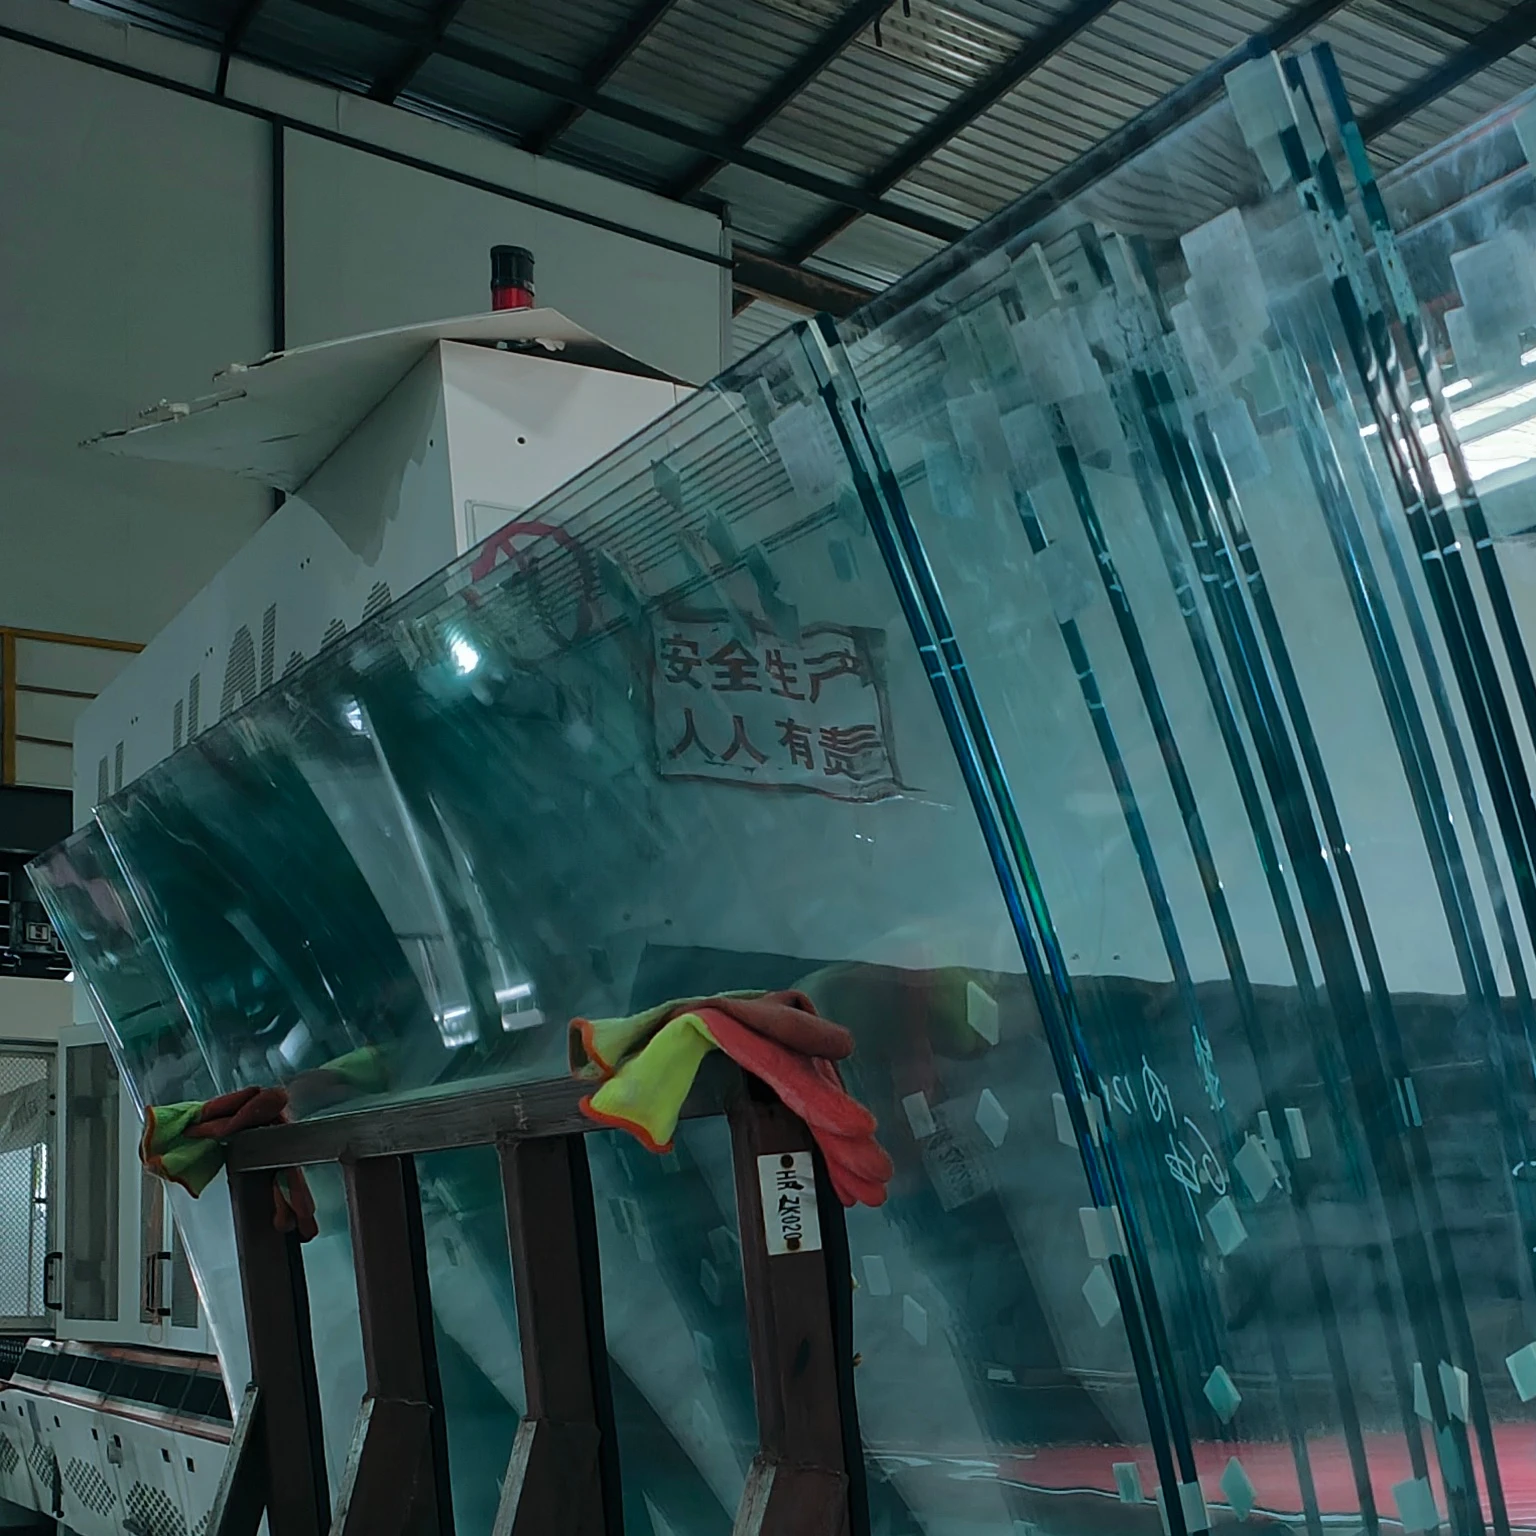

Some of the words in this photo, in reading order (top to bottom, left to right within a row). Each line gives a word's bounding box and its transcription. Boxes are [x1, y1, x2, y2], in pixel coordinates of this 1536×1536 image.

[660, 633, 862, 704] 安全生产
[667, 708, 883, 780] 人人有责
